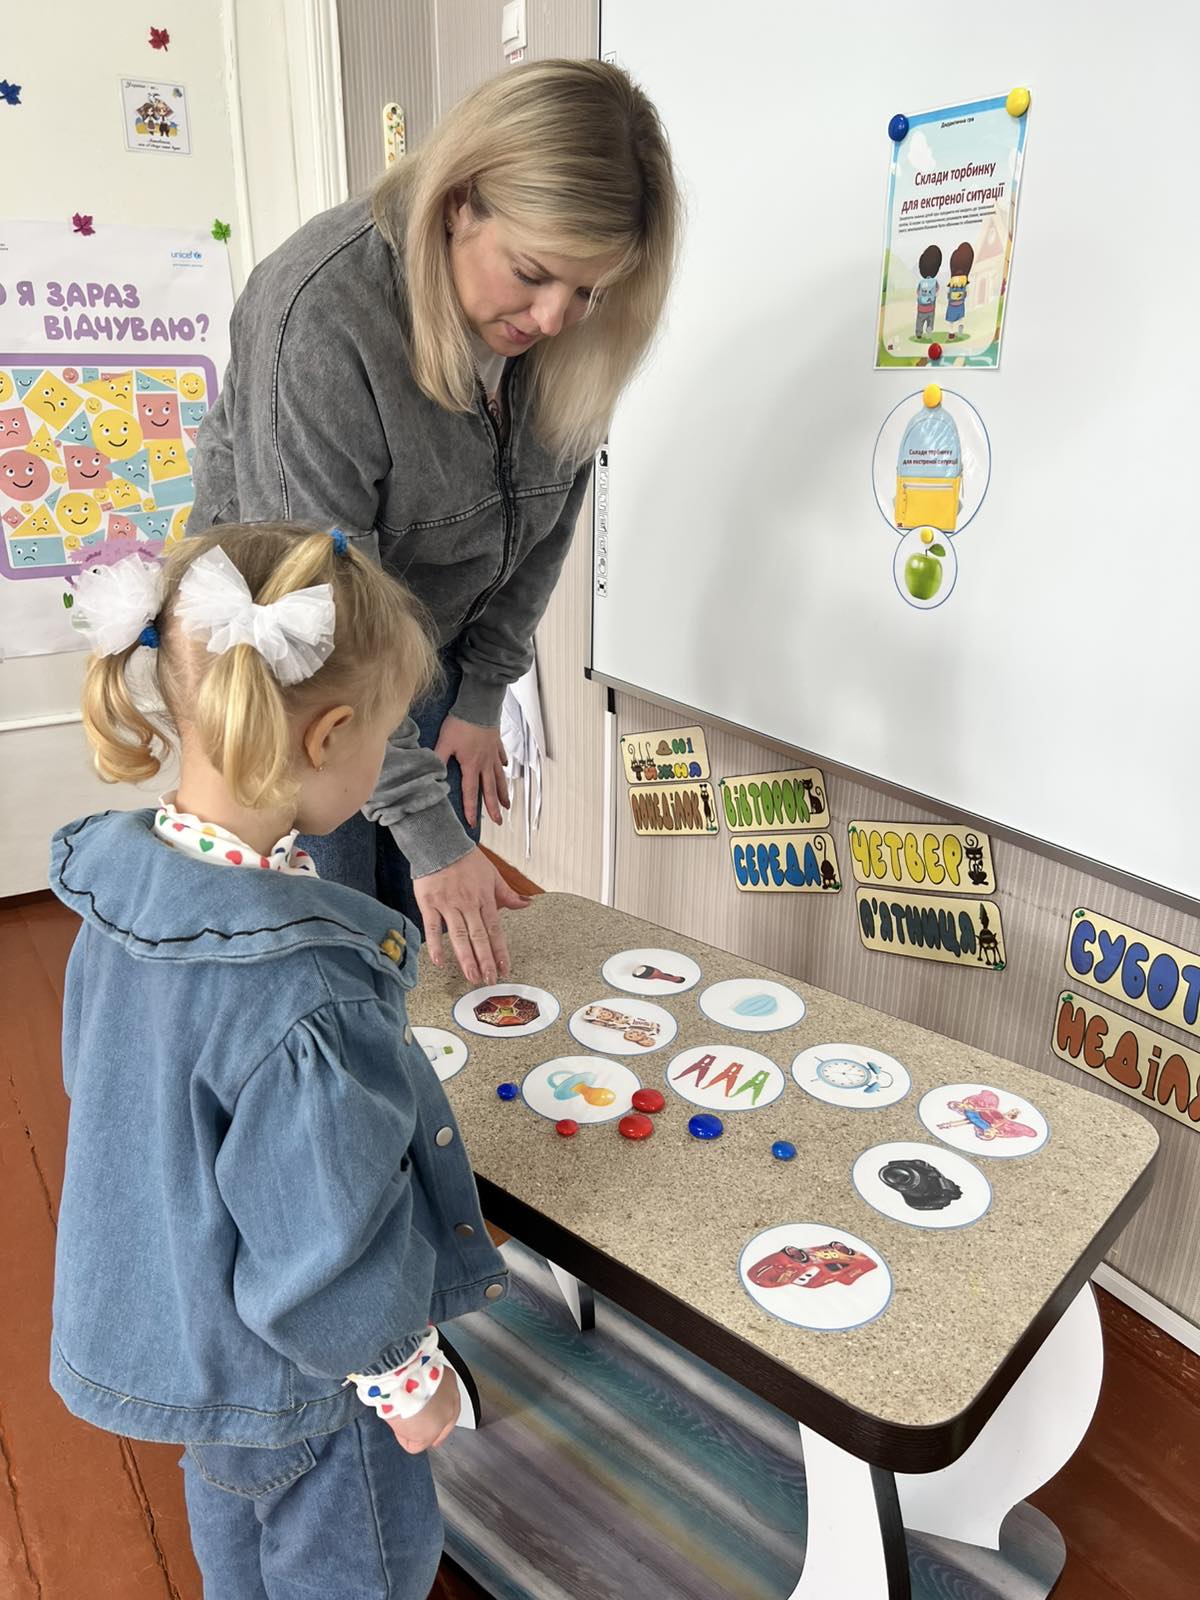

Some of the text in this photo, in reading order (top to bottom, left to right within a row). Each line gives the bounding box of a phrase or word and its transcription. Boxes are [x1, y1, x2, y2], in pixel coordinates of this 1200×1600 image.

[915, 162, 996, 186] Склади торбинку
[901, 199, 919, 214] для
[920, 188, 966, 209] екстреної
[966, 182, 1005, 204] ситуації
[171, 250, 193, 259] unicef
[16, 281, 36, 306] Я
[46, 281, 141, 309] ЗАРАЗ
[43, 311, 210, 343] ВІДЧУВАЮ?
[733, 841, 822, 887] СЕРЕДА
[851, 829, 963, 887] ЧЕТВЕР
